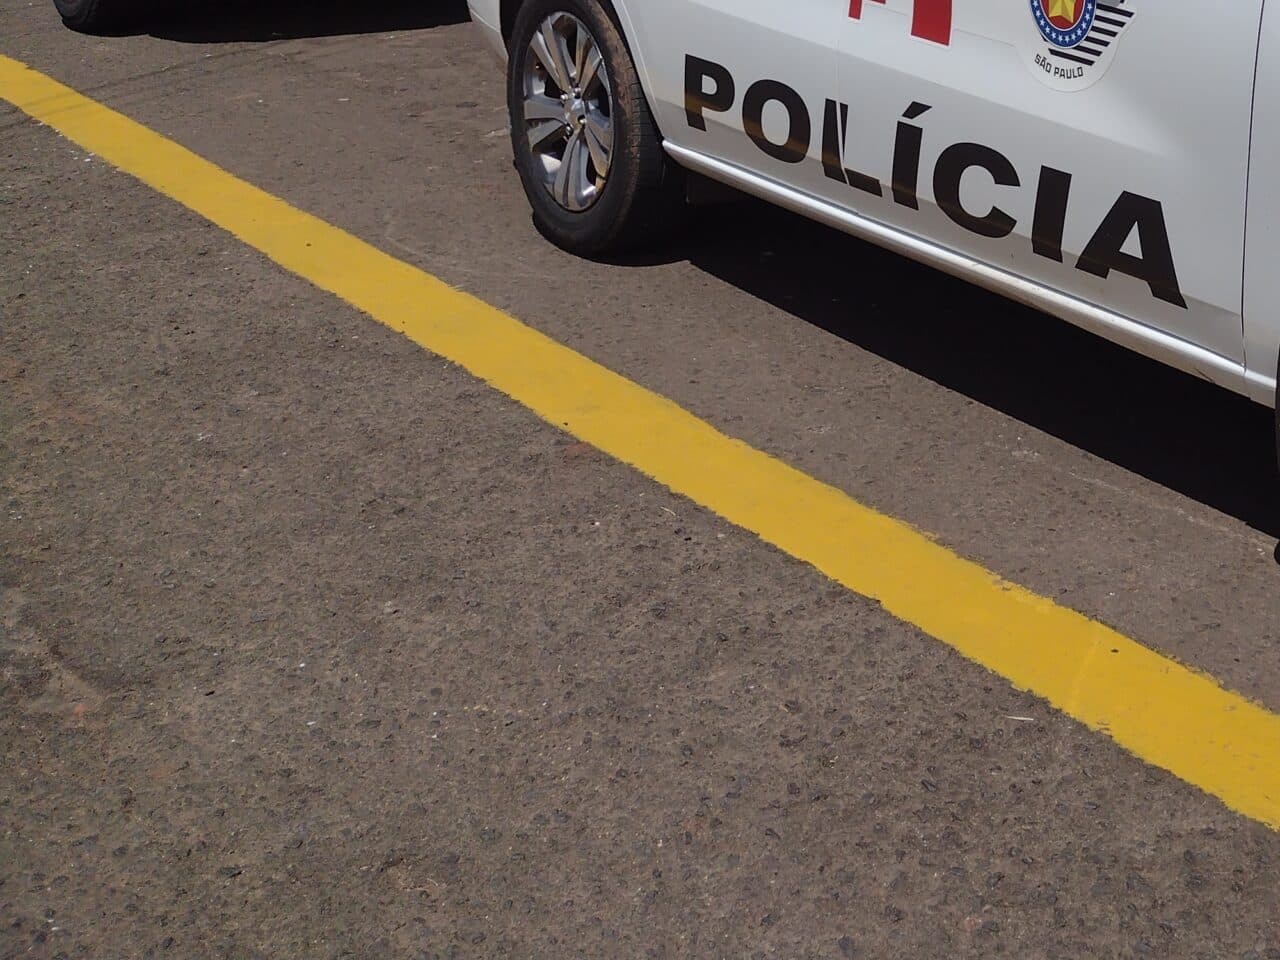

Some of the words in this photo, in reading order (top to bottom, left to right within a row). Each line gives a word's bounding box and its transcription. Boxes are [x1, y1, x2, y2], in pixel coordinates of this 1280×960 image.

[1034, 53, 1051, 74] SÃO
[1053, 66, 1084, 79] PAULO
[684, 53, 1188, 309] POLÍCIA
